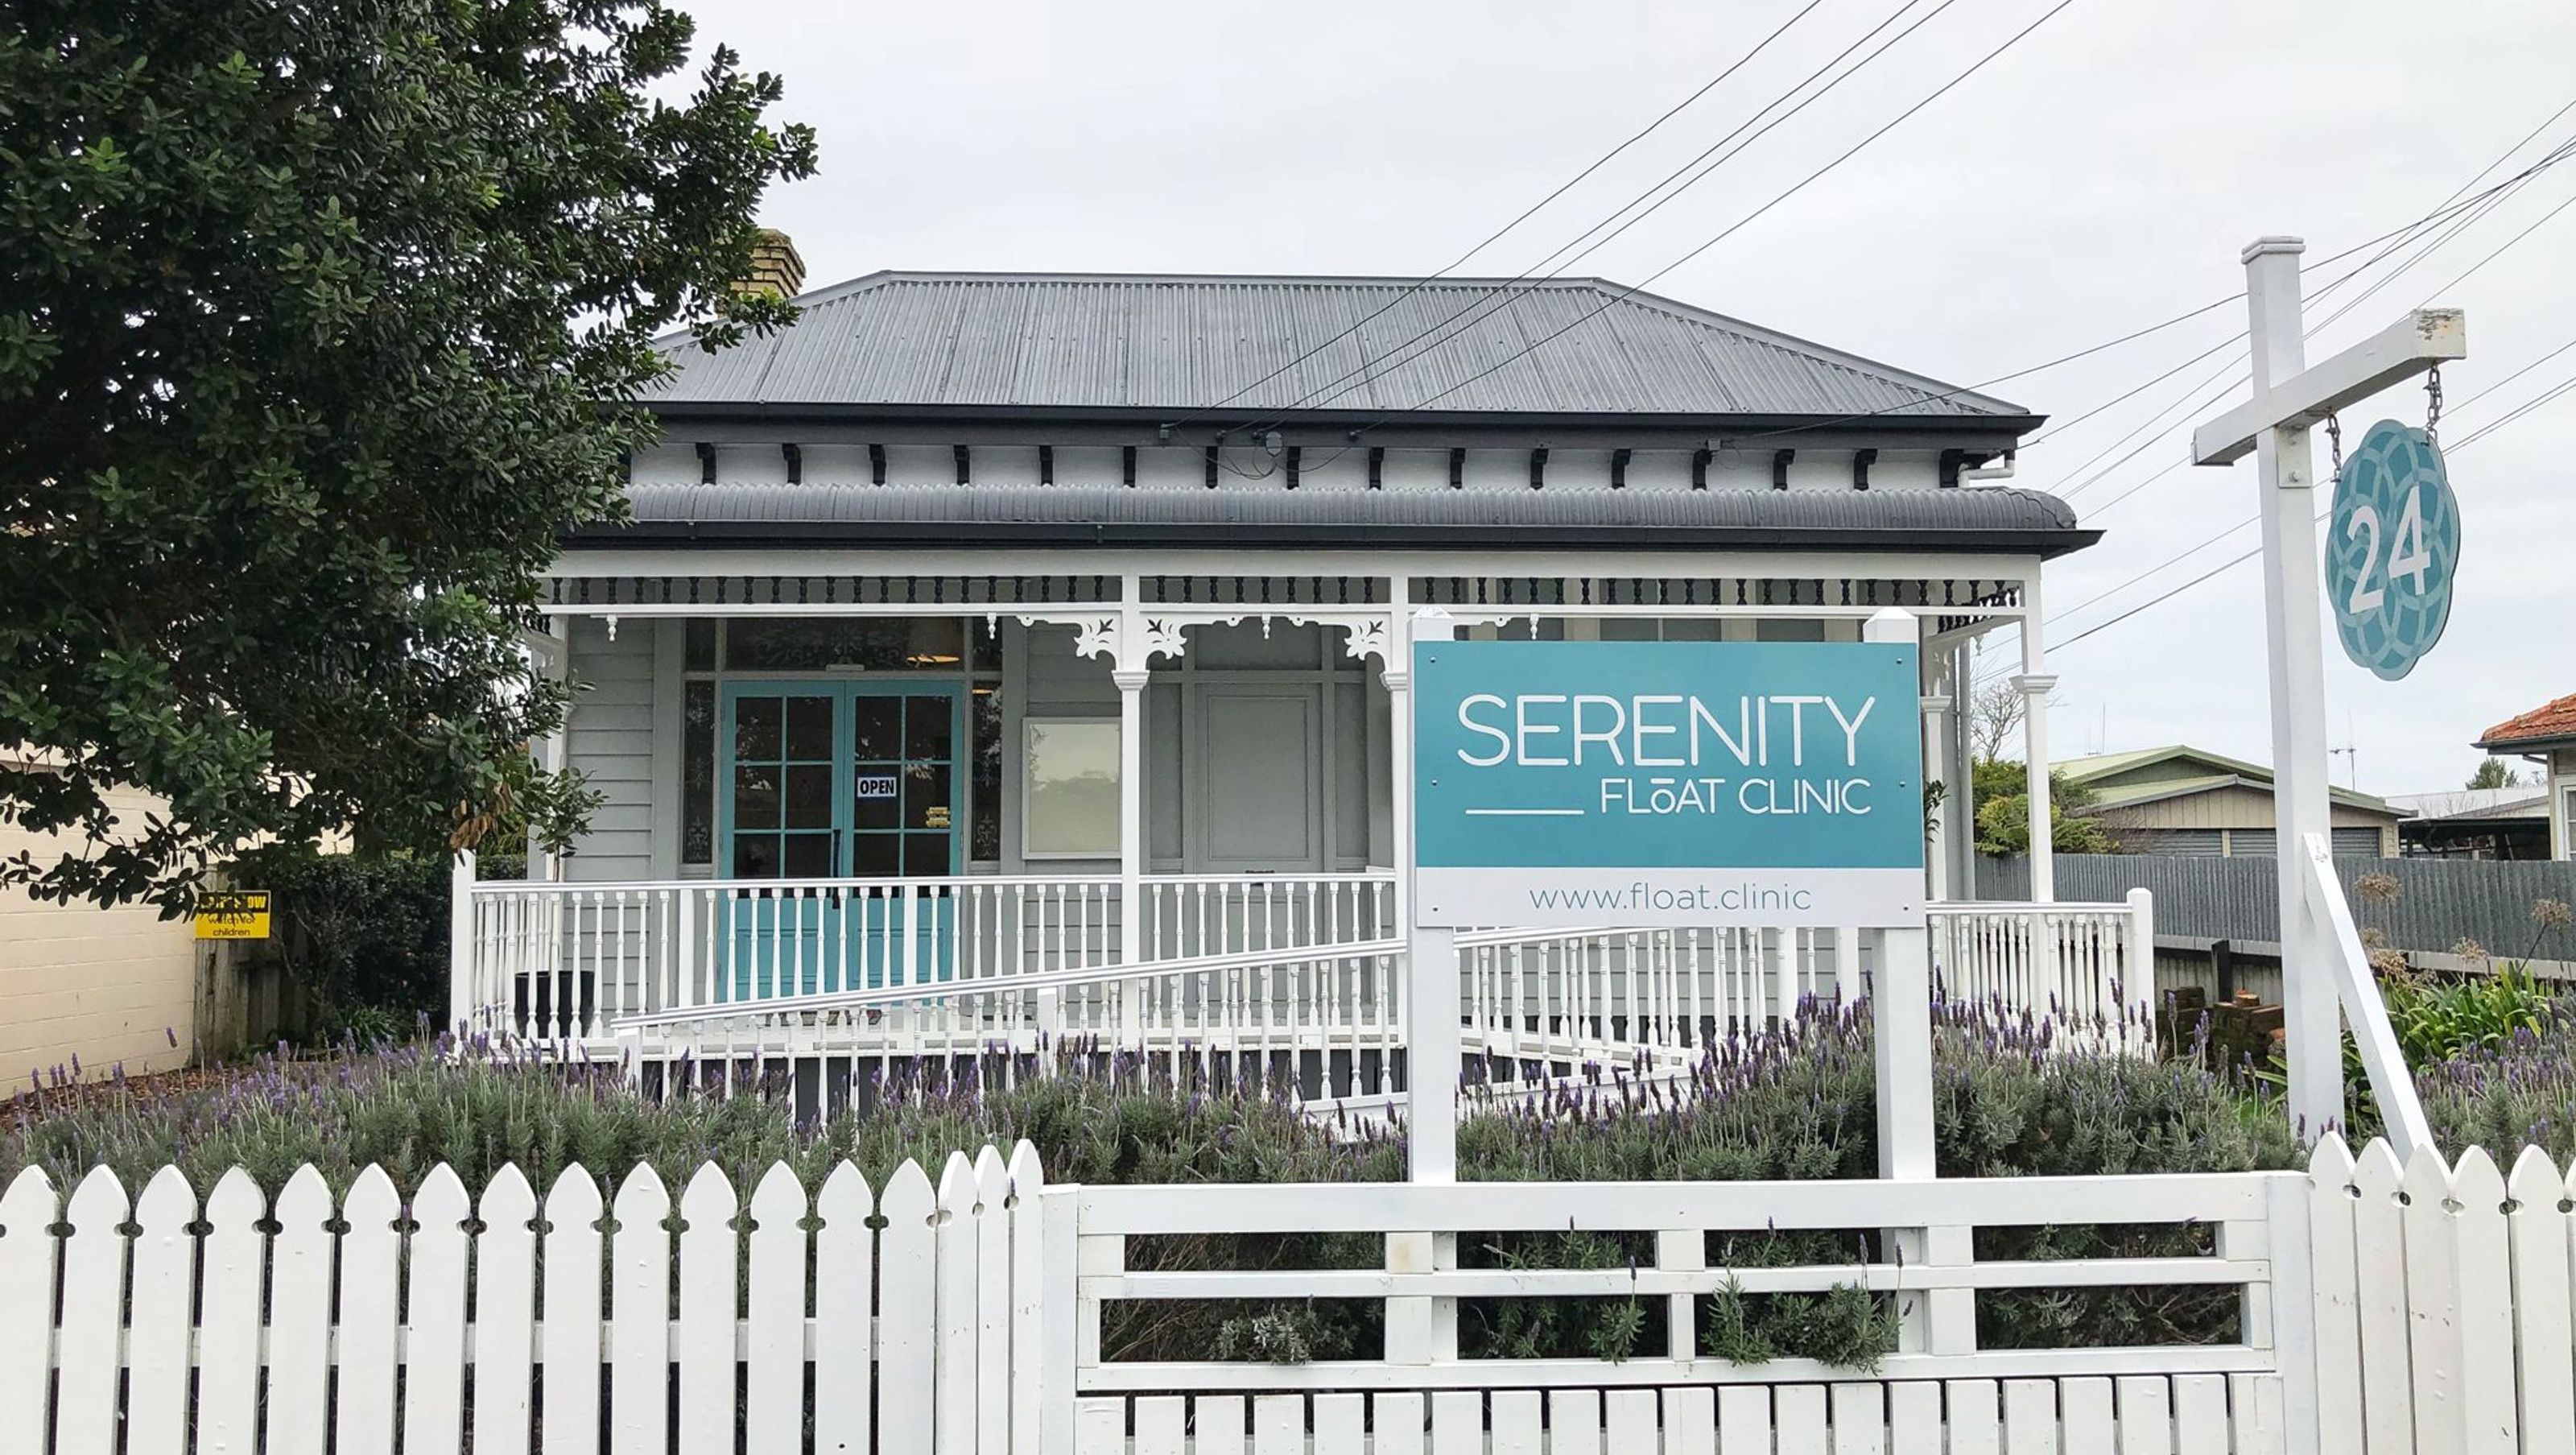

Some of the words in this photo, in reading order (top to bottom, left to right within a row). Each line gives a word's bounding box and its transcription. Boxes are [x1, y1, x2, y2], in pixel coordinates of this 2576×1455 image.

[2347, 482, 2430, 614] 24
[1458, 695, 1876, 767] SERENITY
[860, 779, 894, 794] OPEN
[1739, 779, 1871, 814] CLINIC
[1530, 883, 1811, 911] www.float.clinic
[208, 914, 239, 924] wtch
[213, 928, 250, 936] children
